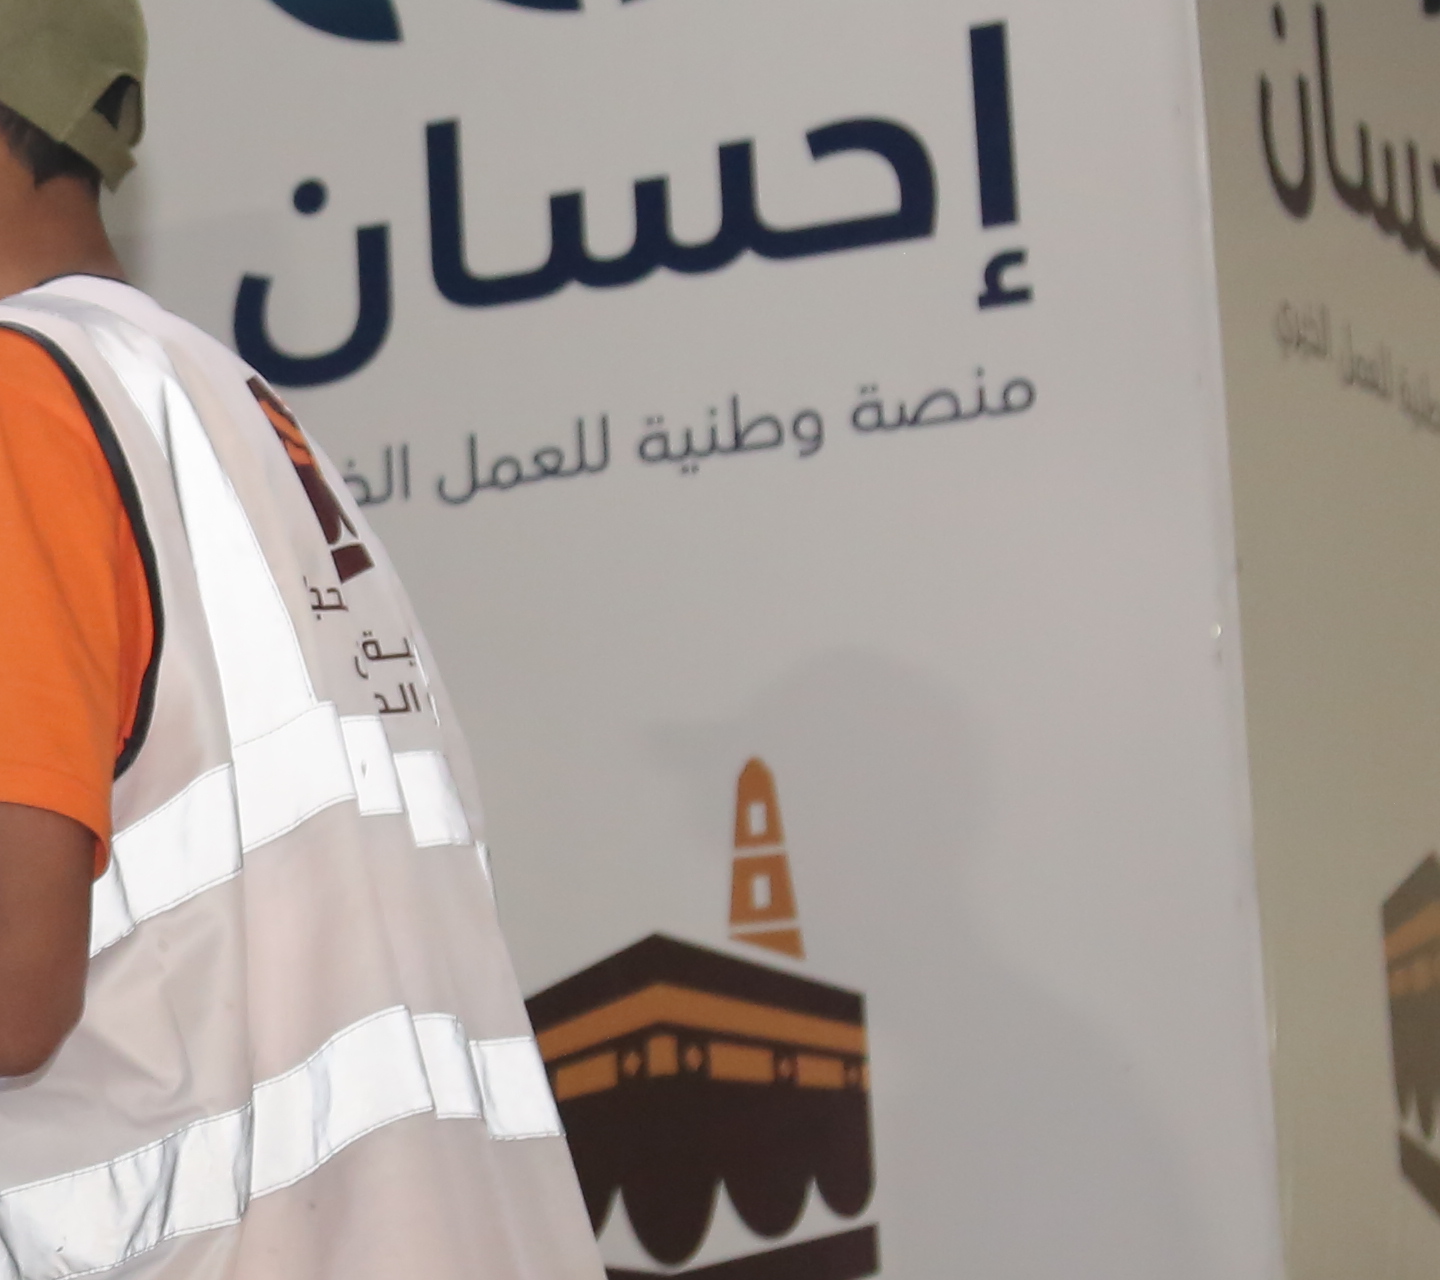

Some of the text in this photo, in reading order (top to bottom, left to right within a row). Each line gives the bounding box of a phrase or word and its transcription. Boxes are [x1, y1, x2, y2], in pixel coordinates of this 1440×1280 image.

[231, 19, 1036, 389] إحسان
[342, 366, 1036, 508] منصة وطنية للعمل الخ
